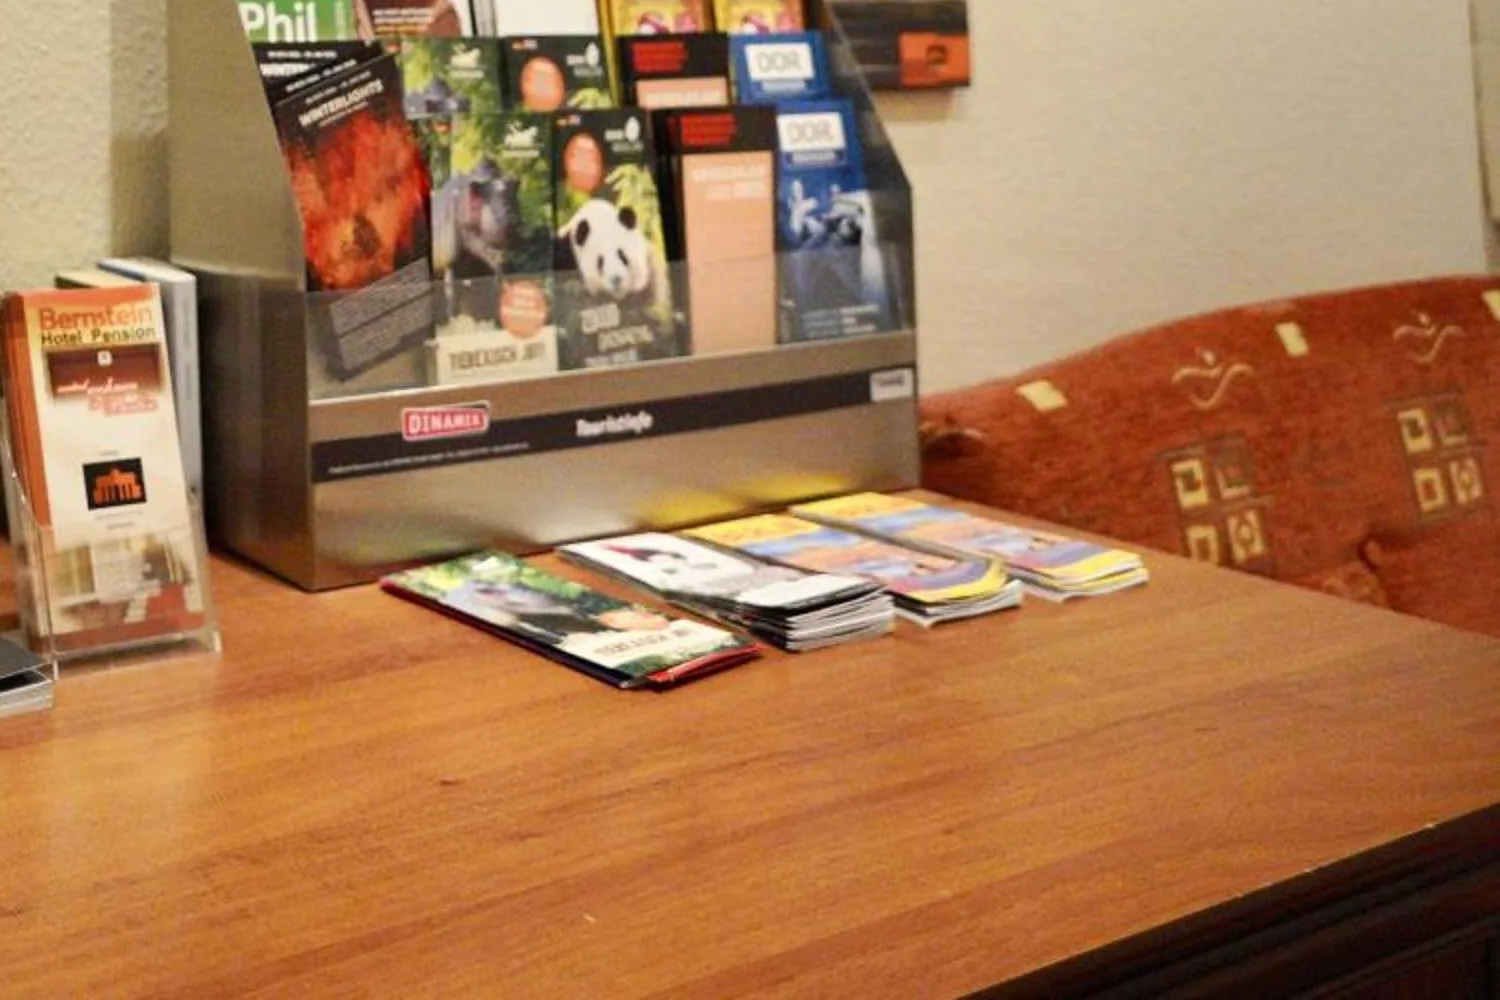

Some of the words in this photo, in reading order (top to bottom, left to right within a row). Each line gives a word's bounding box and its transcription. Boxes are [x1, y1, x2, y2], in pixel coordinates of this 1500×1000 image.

[239, 0, 318, 43] Phil
[757, 53, 803, 73] DDR
[788, 122, 835, 144] DDR
[38, 303, 154, 331] Bernstein
[40, 329, 83, 346] Hotel
[90, 326, 156, 343] Pension
[408, 412, 481, 435] DINAMIX
